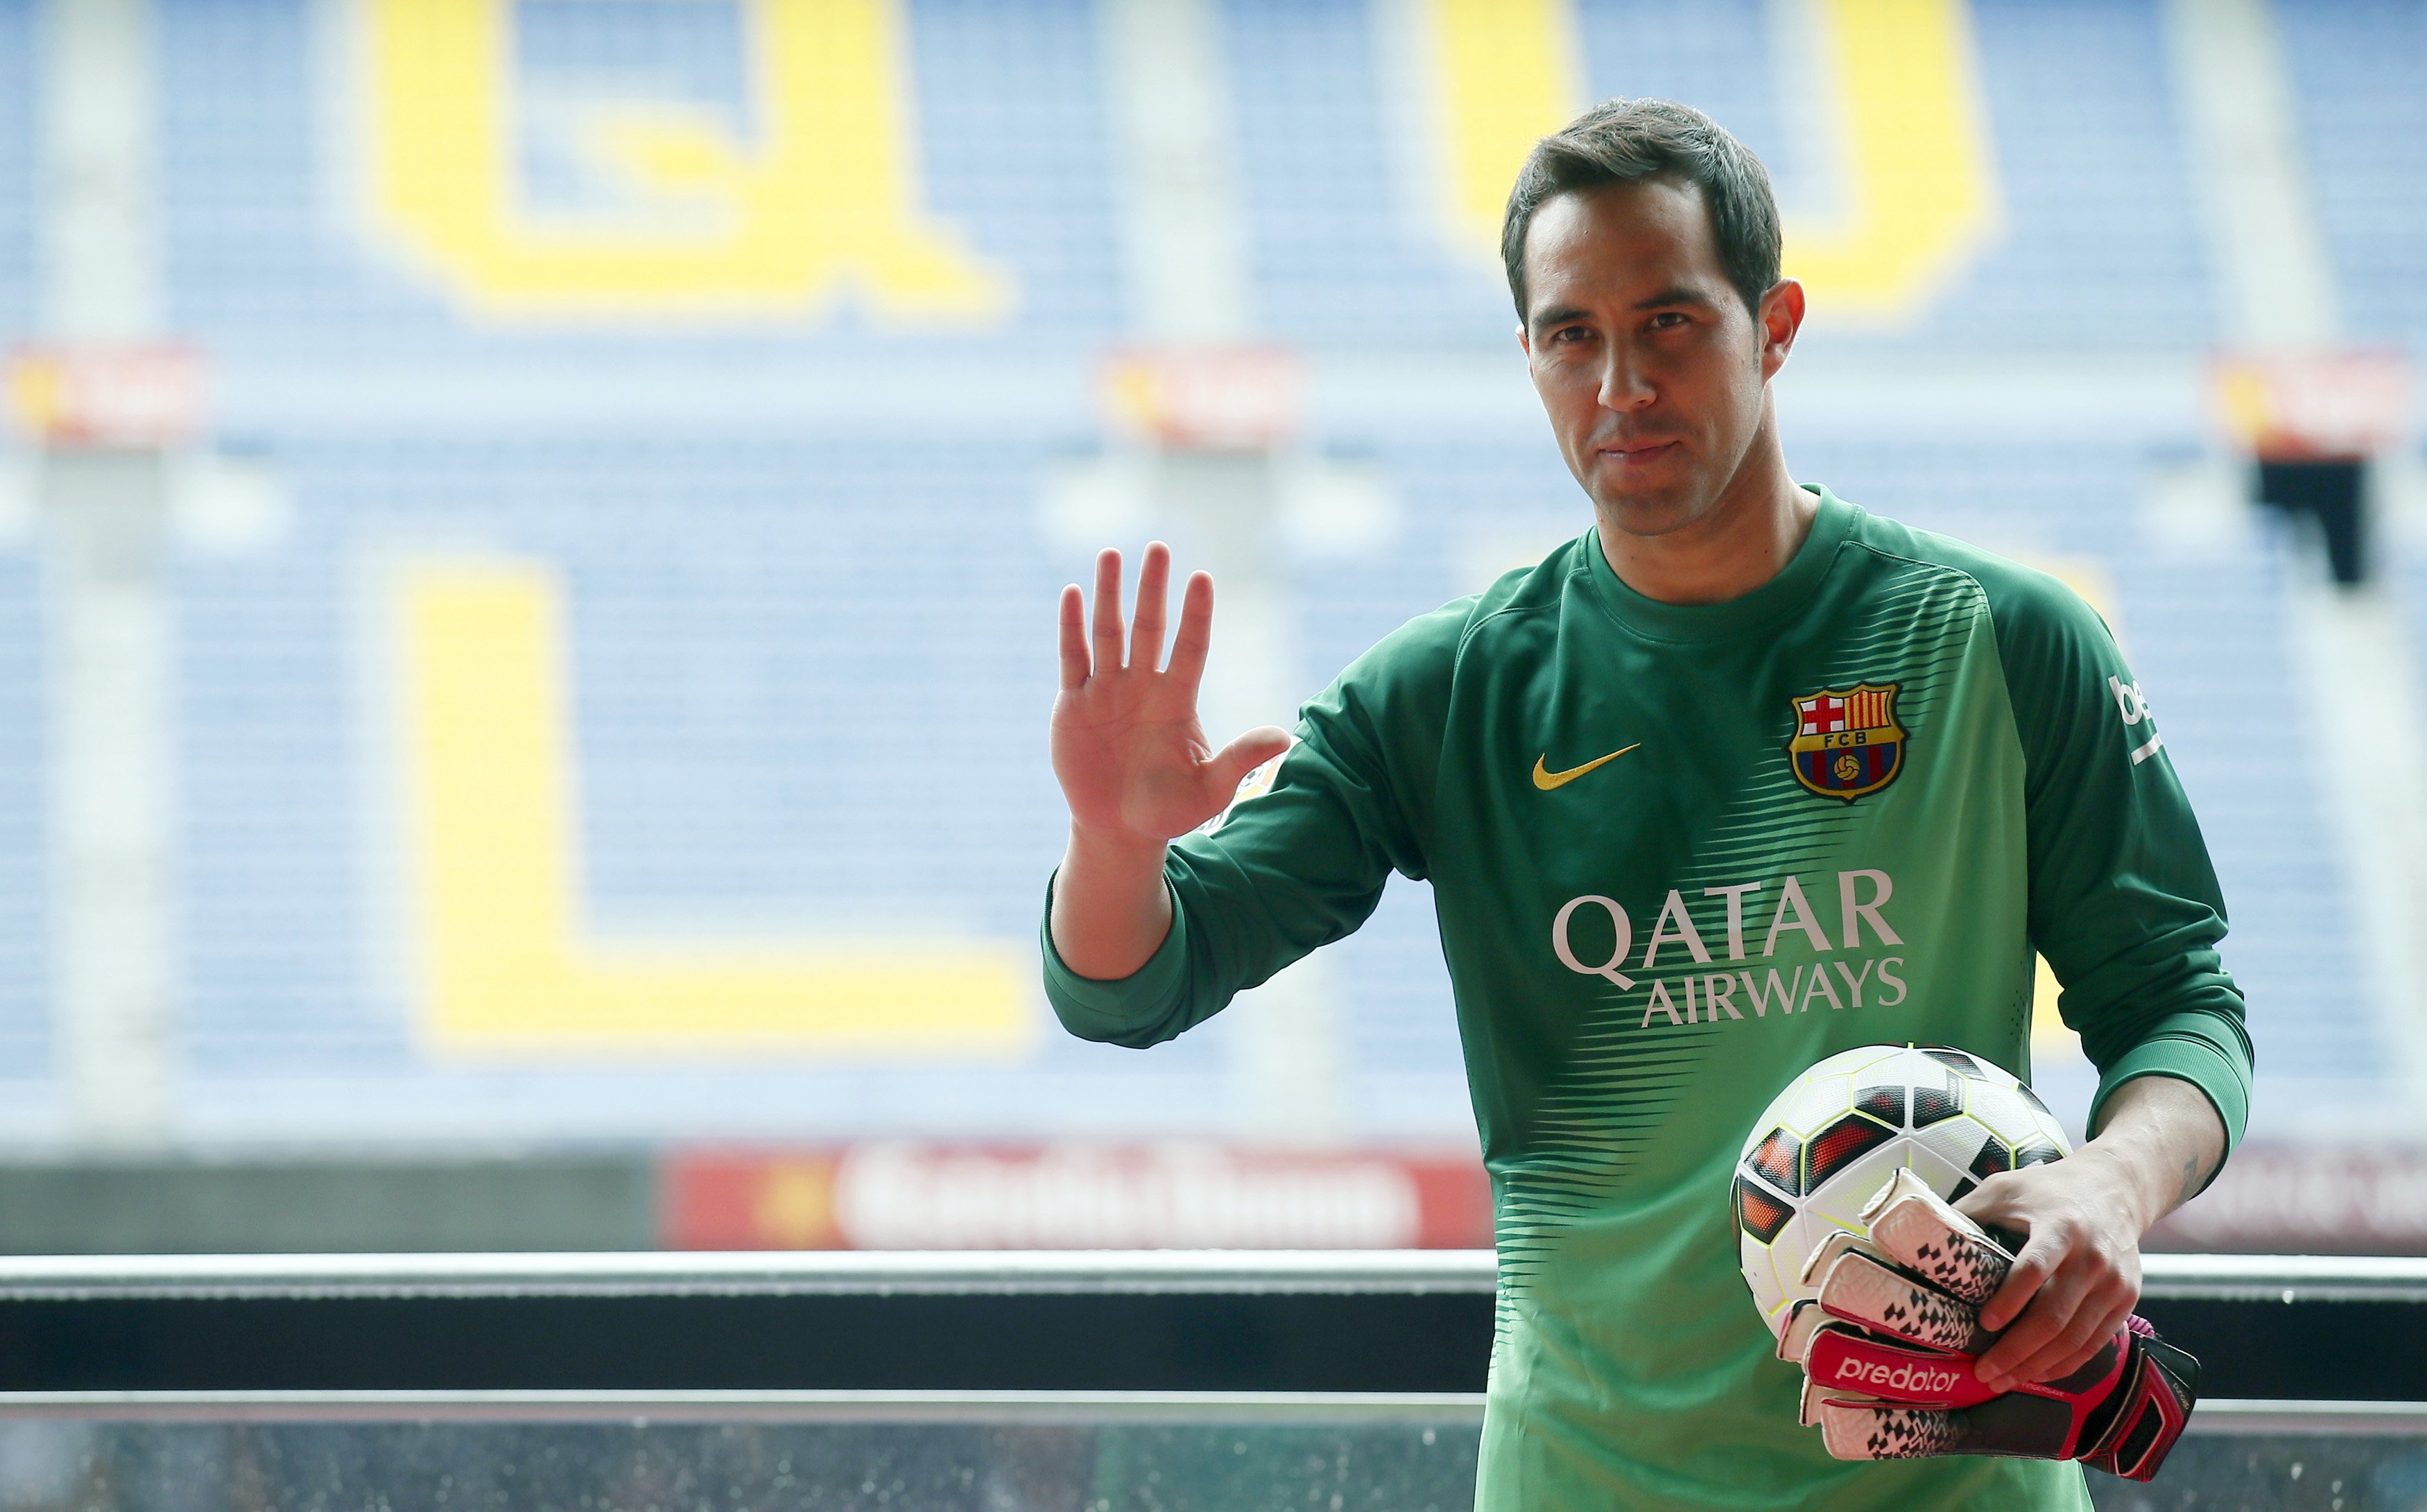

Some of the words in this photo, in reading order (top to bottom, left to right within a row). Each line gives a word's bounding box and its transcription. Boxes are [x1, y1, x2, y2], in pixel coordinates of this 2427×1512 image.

[1824, 731, 1867, 748] FCB
[1552, 869, 1904, 991] QATAR
[1641, 957, 1908, 1029] AIRWAYS
[1834, 1356, 1960, 1392] predator
